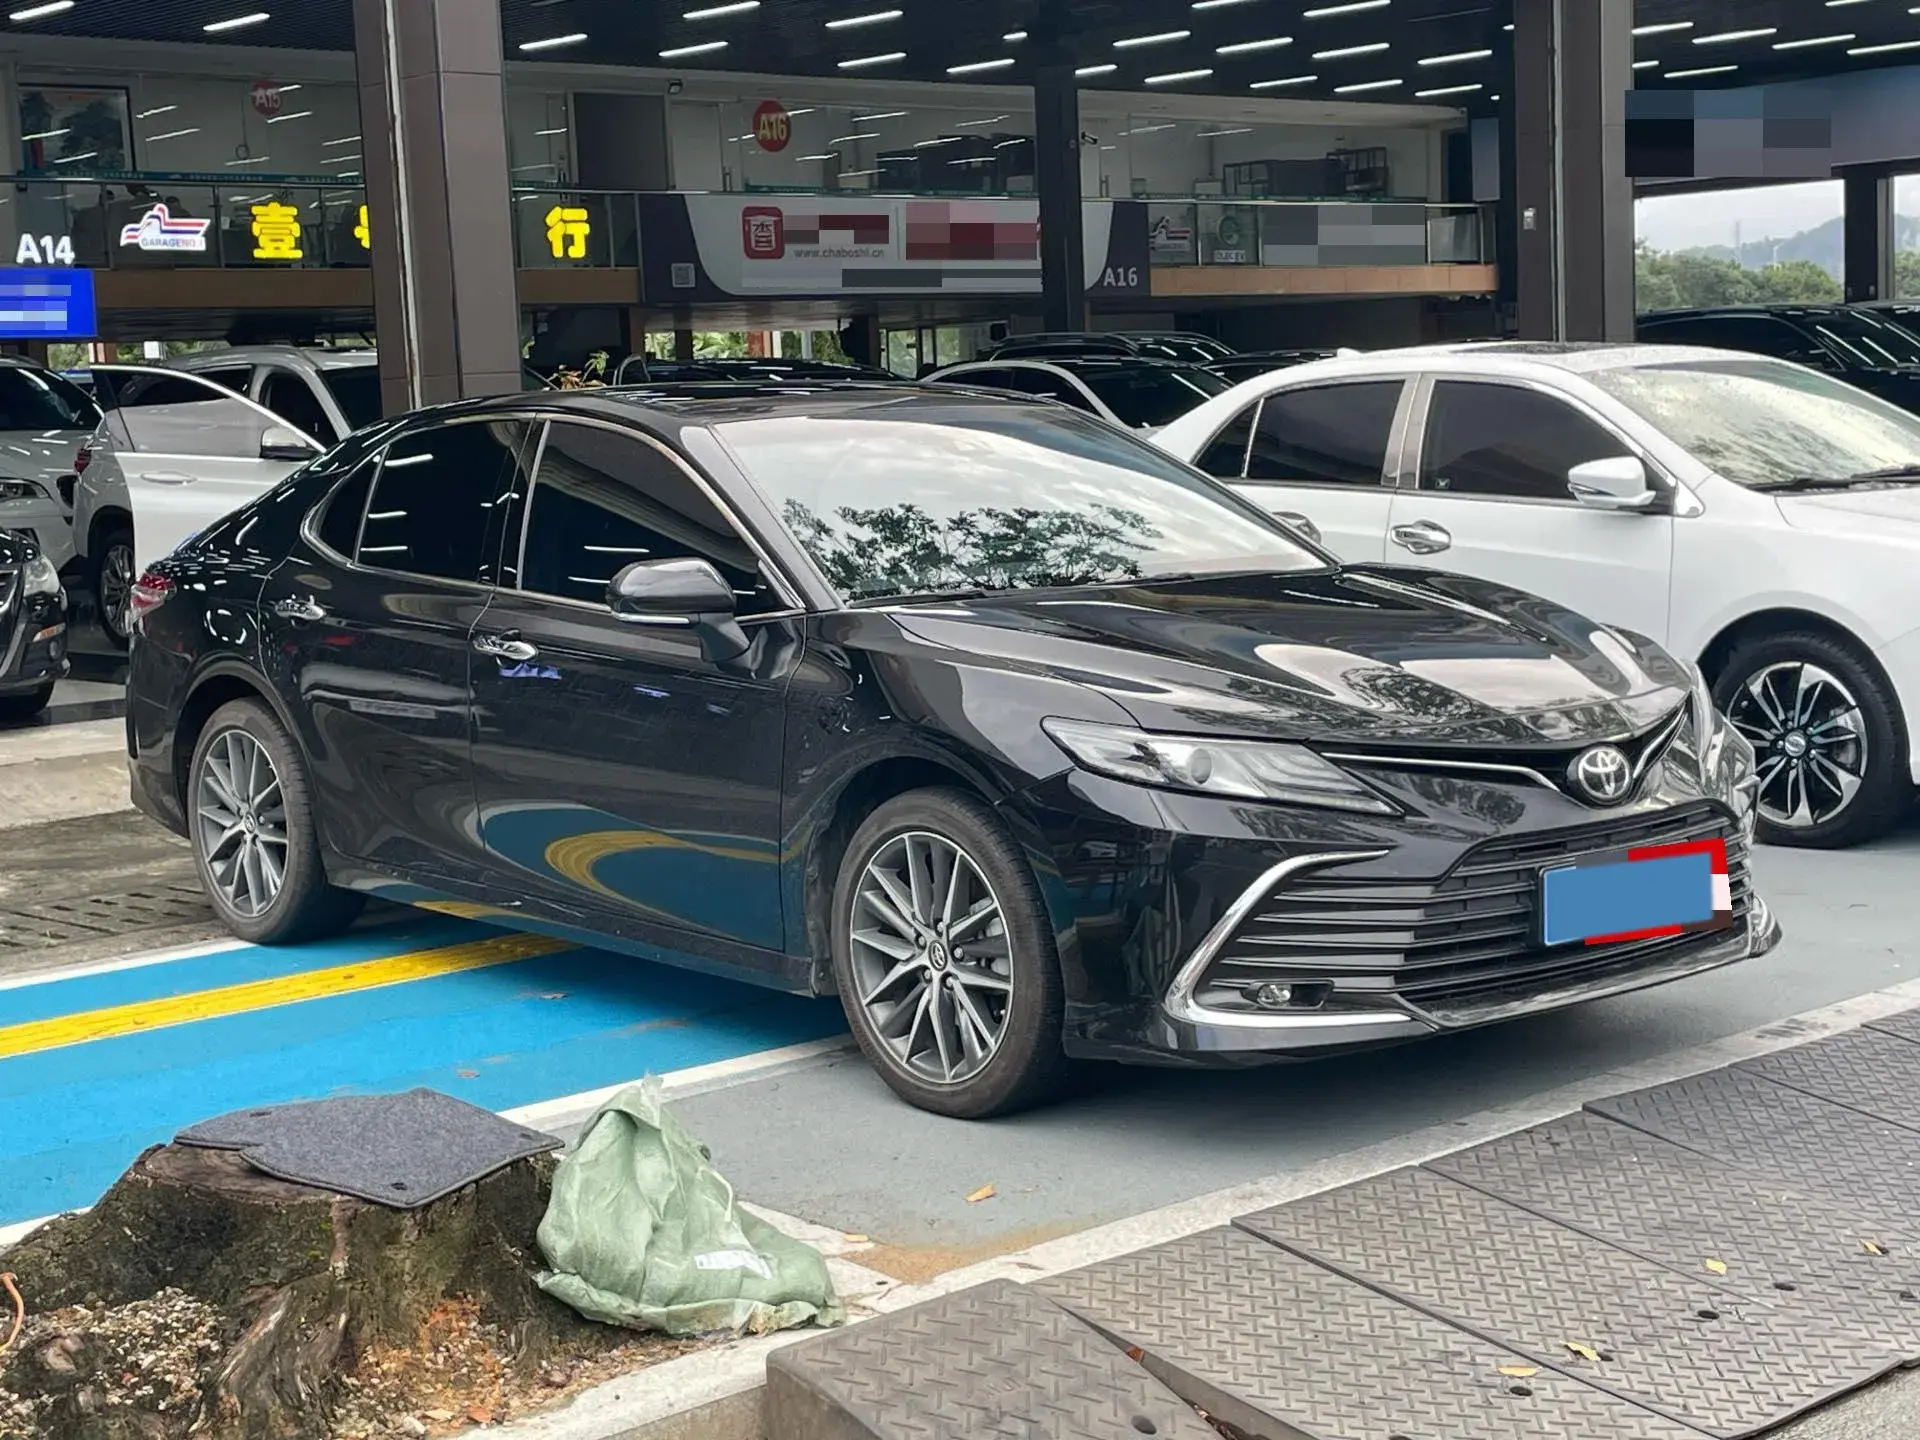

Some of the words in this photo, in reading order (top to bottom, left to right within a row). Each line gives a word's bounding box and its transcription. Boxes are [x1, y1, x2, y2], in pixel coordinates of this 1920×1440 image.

[759, 112, 788, 140] A16
[545, 205, 590, 258] 行
[15, 232, 76, 265] A14
[1103, 266, 1138, 287] A16
